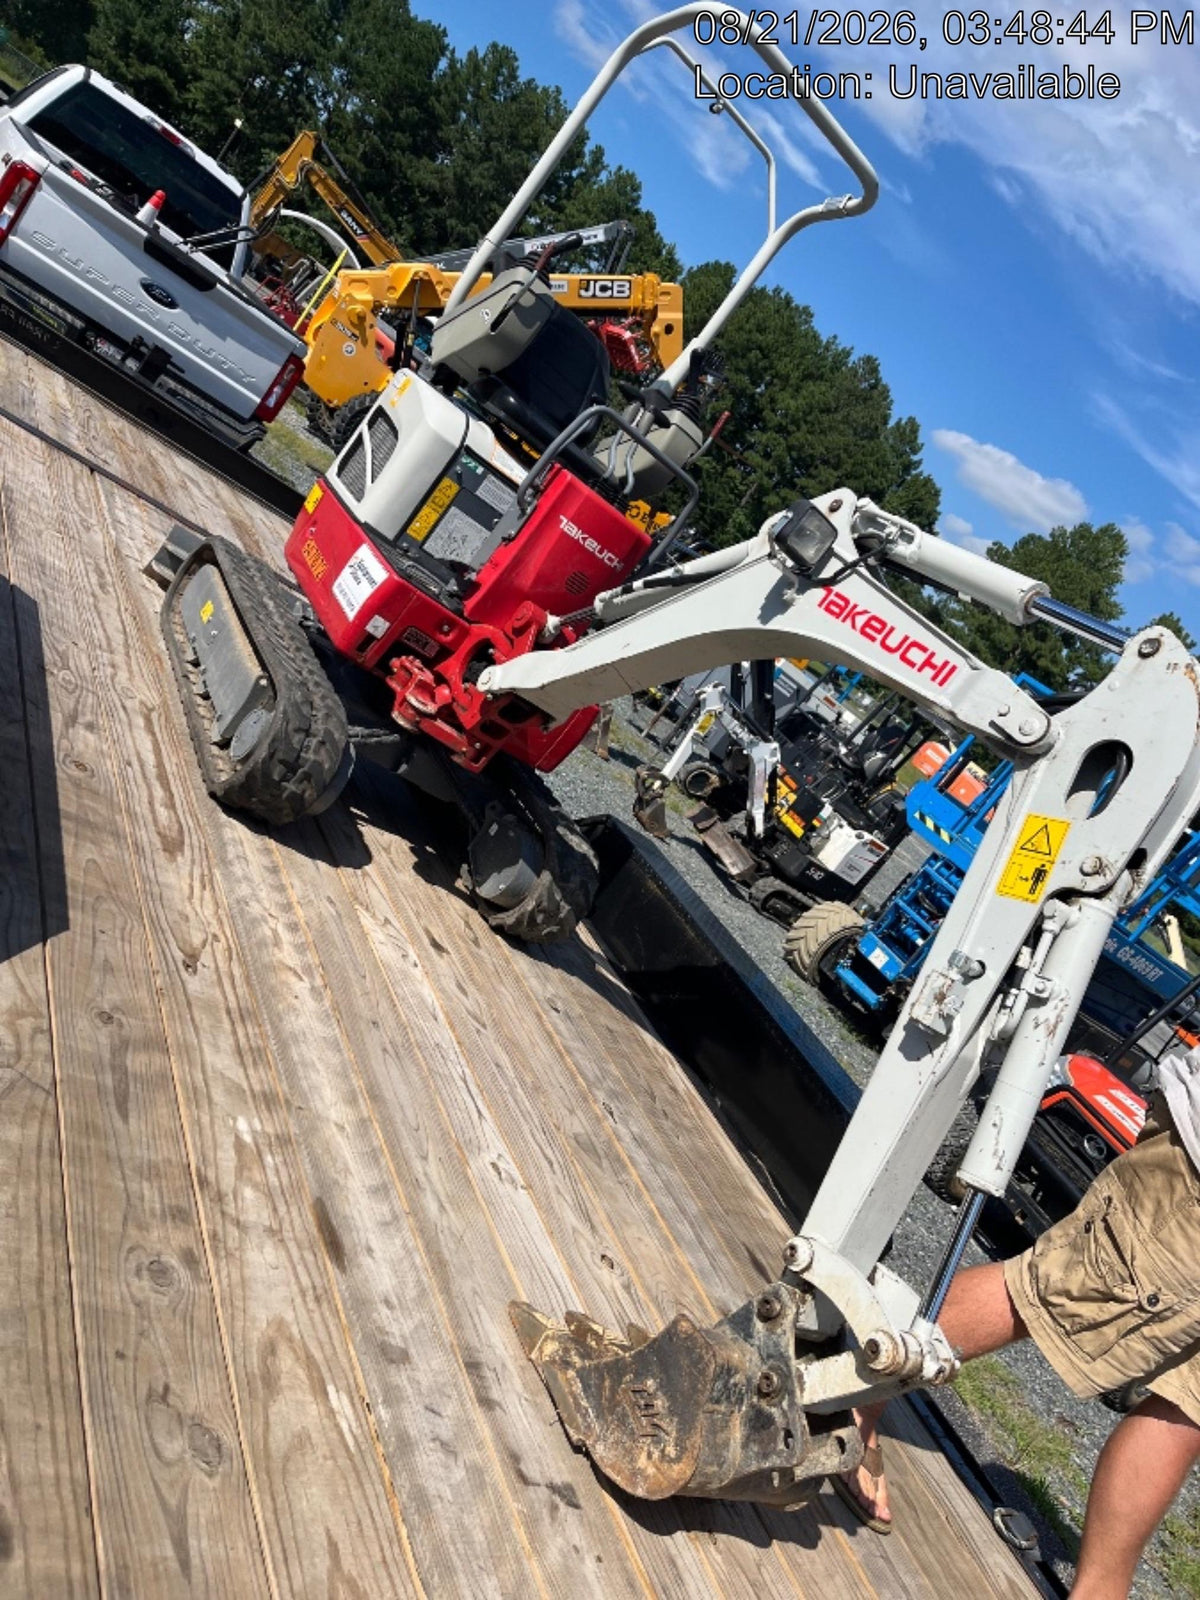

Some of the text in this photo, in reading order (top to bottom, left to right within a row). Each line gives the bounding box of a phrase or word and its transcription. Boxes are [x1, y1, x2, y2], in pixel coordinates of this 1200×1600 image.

[32, 230, 160, 321] SUPER
[168, 321, 257, 383] DUTY
[580, 280, 630, 298] JCB
